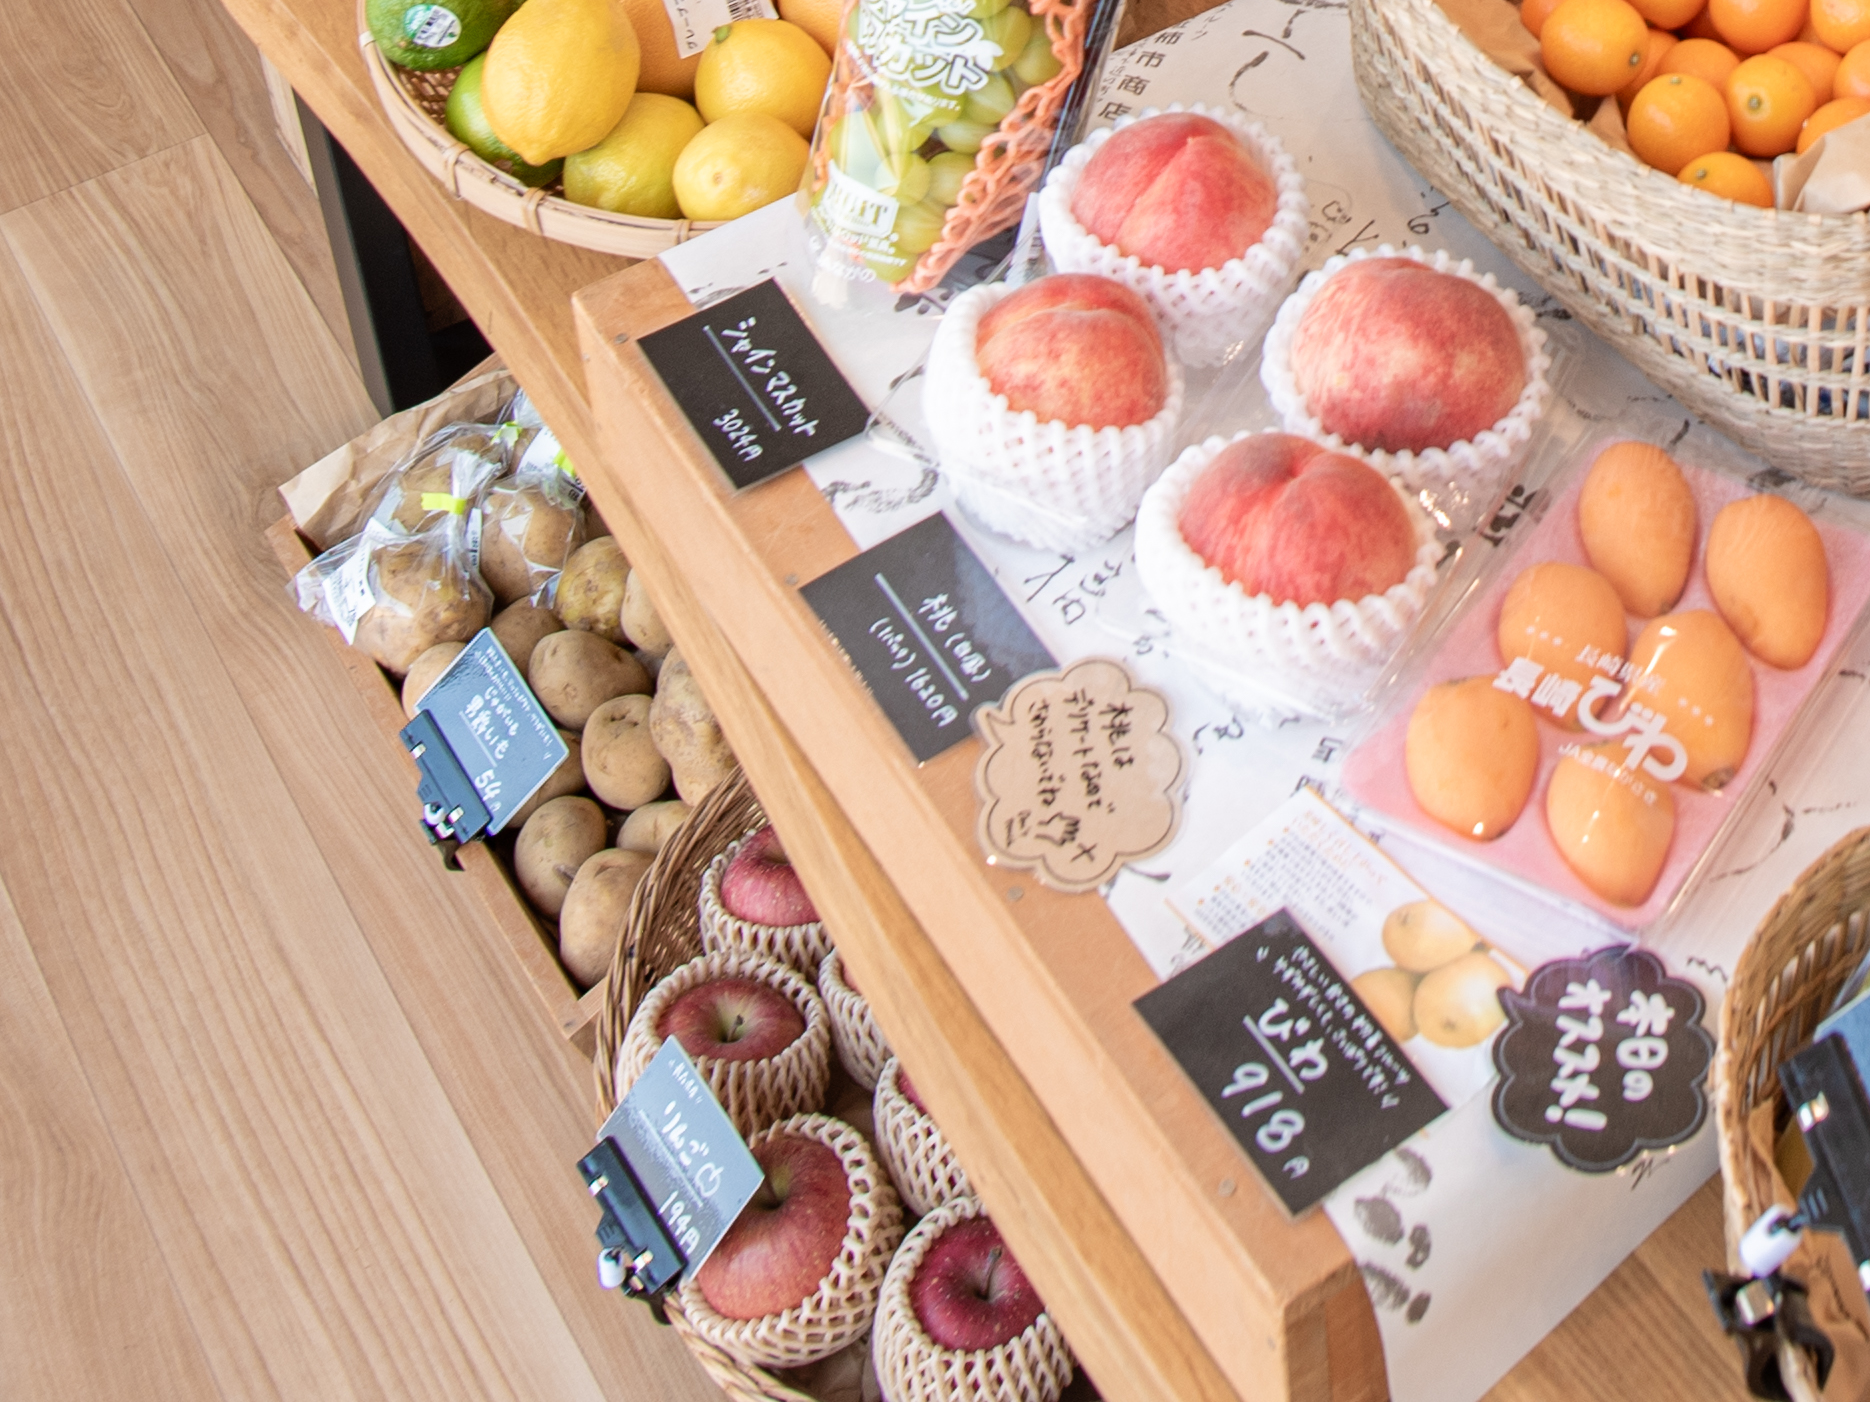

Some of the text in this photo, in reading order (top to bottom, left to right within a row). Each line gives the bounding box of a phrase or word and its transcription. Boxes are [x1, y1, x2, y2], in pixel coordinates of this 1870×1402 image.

[721, 316, 819, 437] シャインマスカット
[713, 409, 763, 462] 3024円
[465, 694, 509, 760] 男爵いも
[904, 666, 958, 728] 1620円
[1098, 702, 1134, 770] 桃は
[1029, 697, 1065, 808] さわらないでね
[1063, 688, 1116, 814] デリケートなので
[1258, 997, 1328, 1081] びわ
[1545, 978, 1612, 1131] オススメ!
[1616, 989, 1675, 1102] 本日の
[663, 1100, 710, 1167] りんご
[1221, 1061, 1310, 1180] 918円
[659, 1190, 700, 1257] 194円
